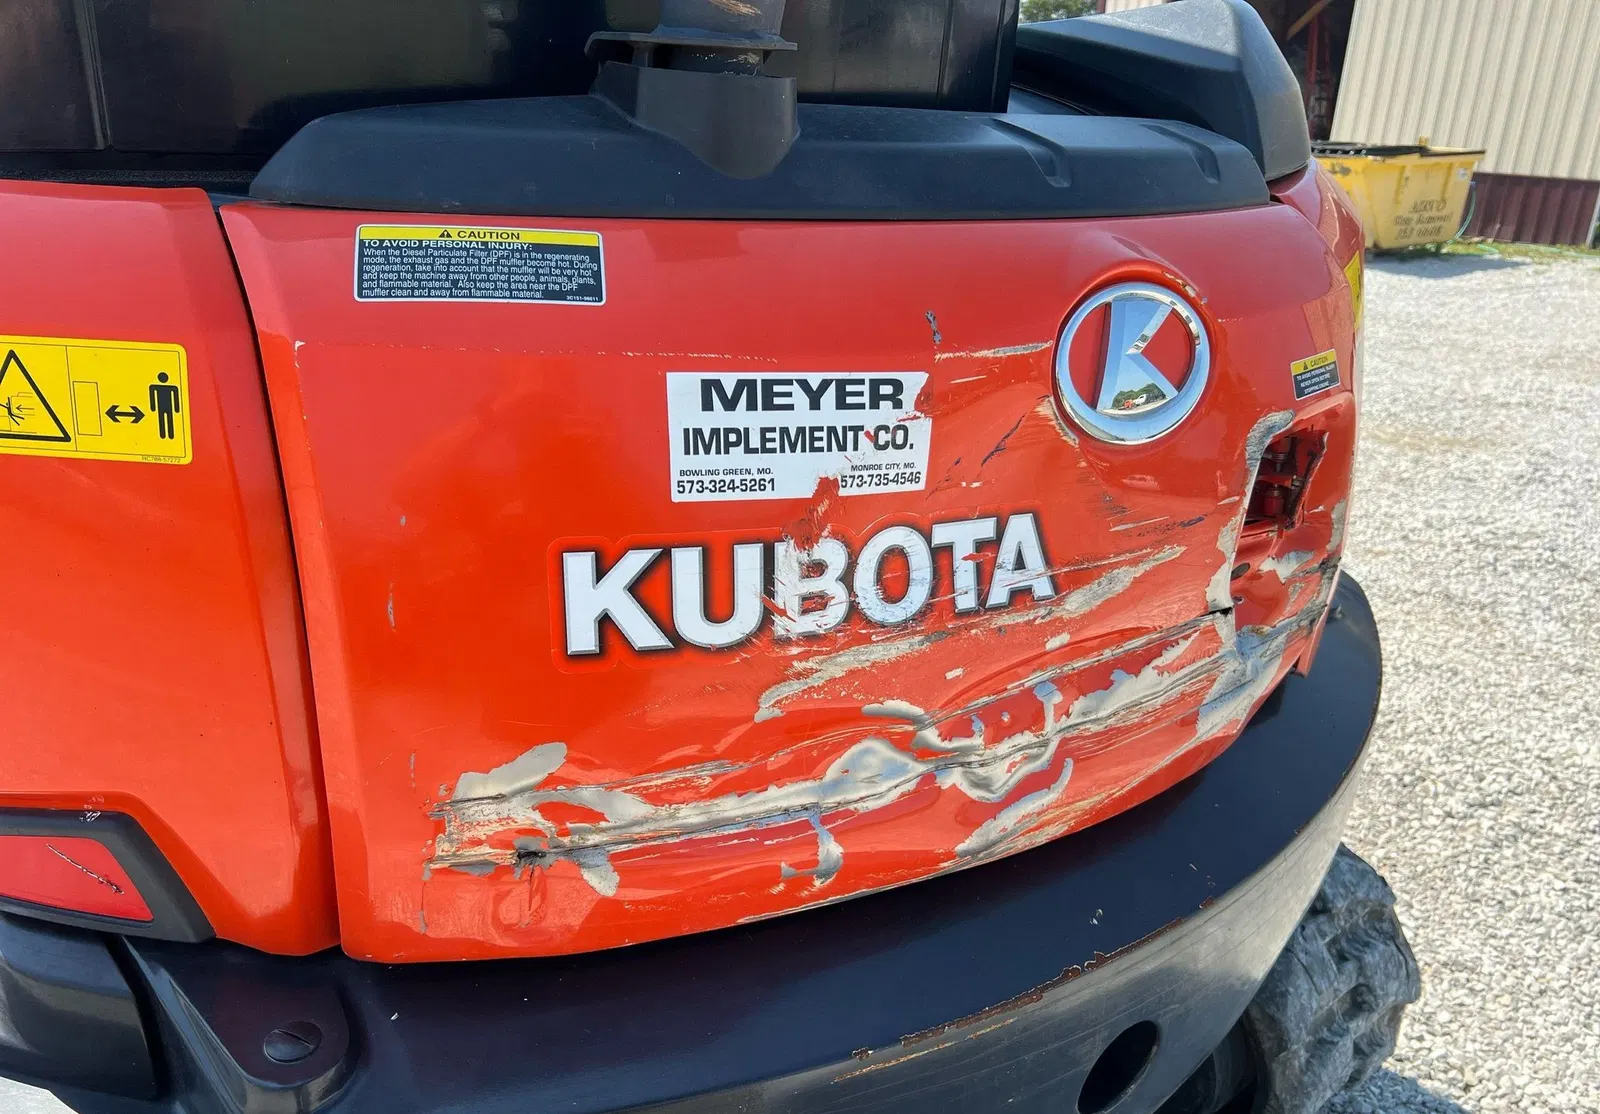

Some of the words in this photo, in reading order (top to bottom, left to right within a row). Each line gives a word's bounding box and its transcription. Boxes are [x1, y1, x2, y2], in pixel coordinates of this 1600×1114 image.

[458, 231, 519, 240] CAUTION
[423, 240, 485, 248] PERSONAL
[489, 242, 532, 250] INJURY:
[490, 250, 511, 258] (DPF)
[544, 253, 589, 263] regenerating
[364, 265, 413, 273] regeneration,
[511, 266, 535, 274] muffler
[527, 259, 556, 267] become
[574, 261, 597, 270] During
[380, 272, 398, 281] keep
[449, 274, 468, 282] away
[511, 274, 537, 282] people,
[540, 275, 569, 283] animals,
[572, 277, 596, 285] plants,
[421, 280, 453, 288] material.
[477, 281, 497, 289] keep
[497, 281, 508, 289] the
[430, 290, 450, 298] away
[472, 289, 510, 297] flammable
[512, 290, 544, 298] material.
[700, 378, 903, 411] MEYER
[683, 425, 865, 455] IMPLEMENT
[873, 424, 914, 451] CO.
[680, 469, 720, 477] BOWLING
[723, 468, 754, 476] GREEN,
[851, 464, 883, 472] MONROE
[885, 463, 901, 471] CITY,
[840, 472, 921, 488] 573-735-4546
[677, 478, 775, 494] 573-324-5261
[562, 512, 1056, 655] KUBOTA
